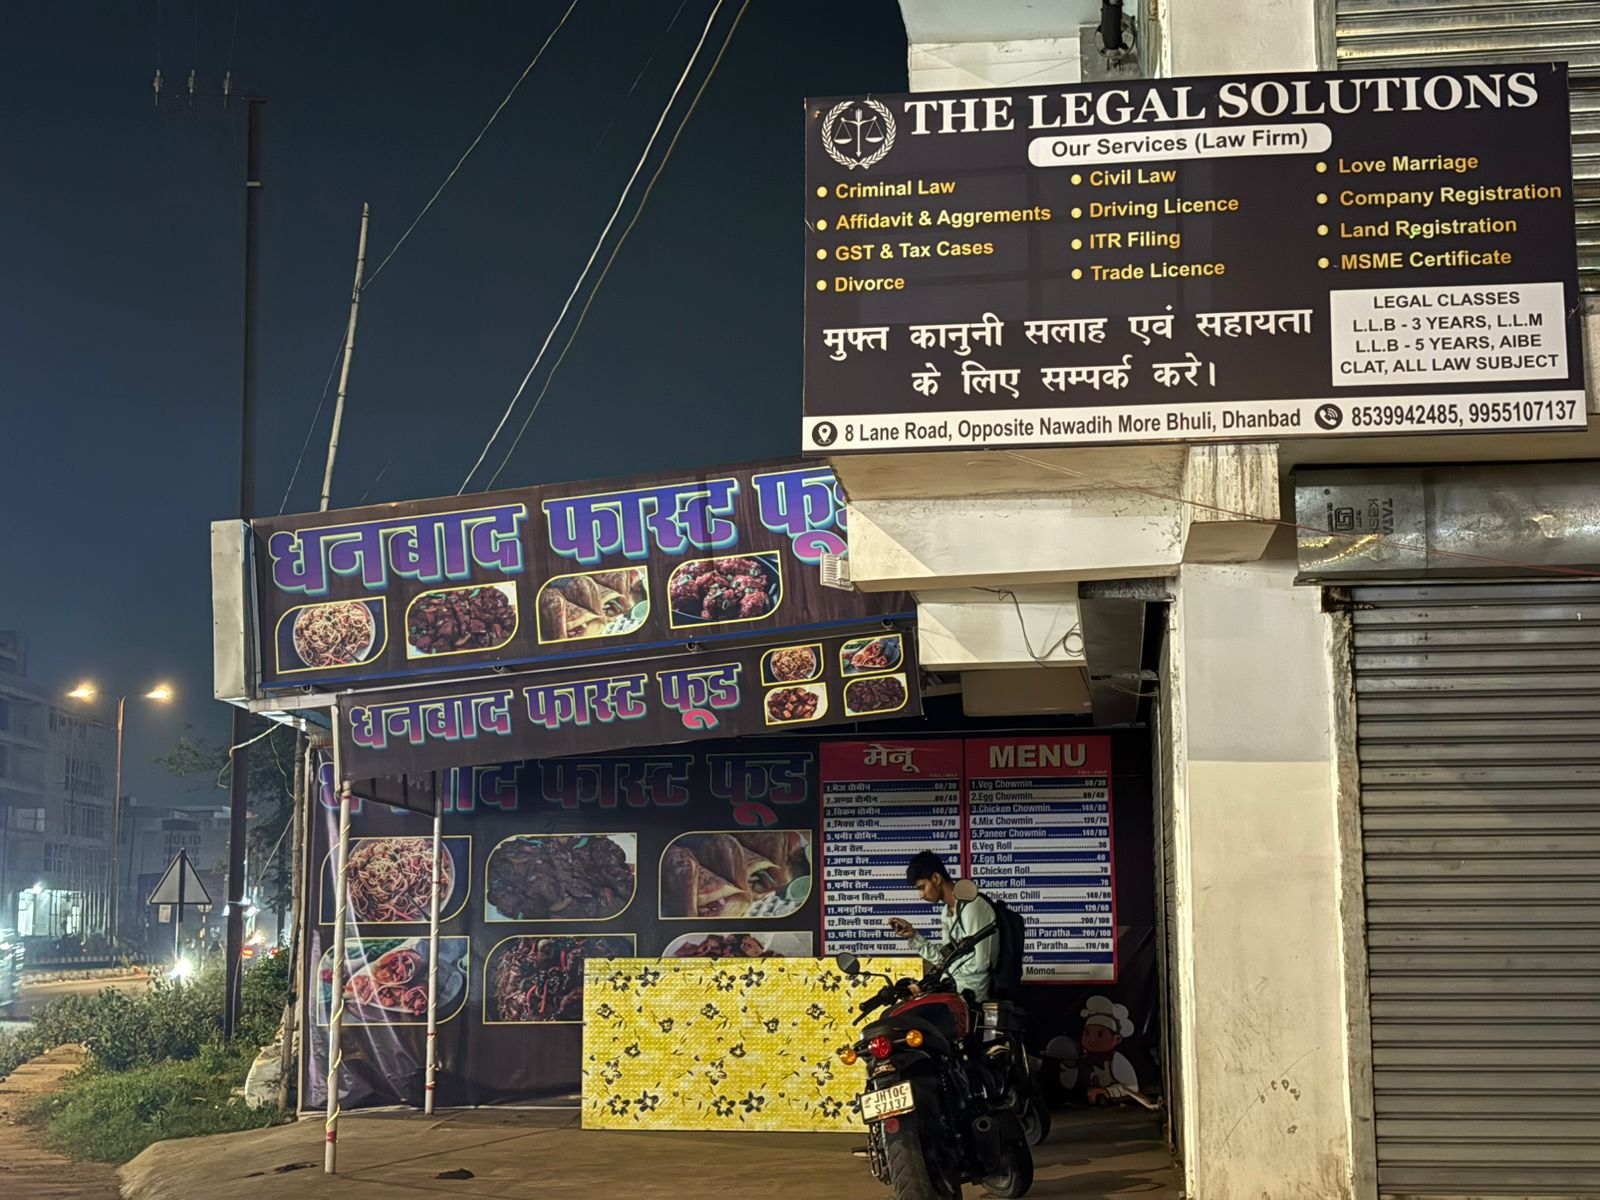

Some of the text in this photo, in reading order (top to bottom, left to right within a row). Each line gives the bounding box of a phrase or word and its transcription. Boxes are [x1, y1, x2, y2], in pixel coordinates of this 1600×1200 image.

[904, 72, 1539, 136] THE LEGAL SOLUTIONS
[1051, 127, 1309, 159] Our Services (Law Firm)
[1338, 154, 1479, 176] Love Marriage
[1089, 169, 1177, 187] Civil Law
[835, 179, 956, 199] Criminal Law
[1340, 184, 1562, 211] Company Registration
[836, 205, 1052, 231] Affidavit & Aggrements
[1089, 196, 1239, 222] Driving Licence
[1340, 218, 1518, 241] Land Registration
[835, 240, 995, 262] GST & Tax Cases
[1089, 231, 1181, 254] ITR Filing
[1341, 250, 1512, 270] MSME Certificate
[1090, 261, 1226, 282] Trade Licence
[834, 275, 906, 293] Divorce
[1373, 291, 1521, 310] LEGAL CLASSES
[823, 305, 1313, 361] मुफ्त कानुनी सलाह एवं सहायता
[1352, 317, 1396, 333] L.L.B
[1411, 316, 1422, 331] 3
[1425, 314, 1492, 332] YEARS,
[1496, 312, 1543, 328] L.L.M
[1355, 338, 1399, 354] L.L.B
[1415, 337, 1425, 352] 5
[1428, 335, 1496, 353] YEARS,
[1499, 333, 1542, 350] AIBE
[1339, 353, 1560, 377] CLAT, ALL LAW SUBJECT
[911, 362, 941, 397] के
[961, 360, 1021, 399] लिए
[1040, 354, 1133, 393] सम्पर्क
[844, 399, 1577, 444] 8 Lane Road, Opposite Nawadih More Bhuli, Dhanbad 8539942485, 9955107137
[268, 465, 848, 596] धनबाद फास्ट फू
[349, 662, 742, 749] धनबाद फास्ट फूड
[863, 743, 920, 773] मेनू
[989, 743, 1087, 769] MENU
[538, 752, 814, 829] फास्ट फूड
[995, 778, 1033, 789] Chowmin
[995, 791, 1033, 801] Chowmin
[971, 804, 1011, 814] 3.Chicken
[1012, 803, 1051, 813] Chowmin
[971, 817, 994, 826] 4.Mix
[995, 815, 1033, 825] Chowmin
[971, 829, 1007, 839] 5.Paneer
[1009, 828, 1047, 838] Chowmin
[972, 841, 995, 852] 6.Veg
[996, 841, 1012, 850] Roll
[972, 854, 995, 864] 7.Egg
[996, 853, 1013, 862] Roll
[972, 866, 1012, 875] 8.Chicken
[1014, 865, 1030, 874] Roll
[1010, 878, 1026, 887] Roll
[1023, 890, 1041, 899] Chilli
[1038, 928, 1071, 937] Paratha
[1037, 941, 1068, 950] Paratha
[1025, 966, 1056, 976] Momos
